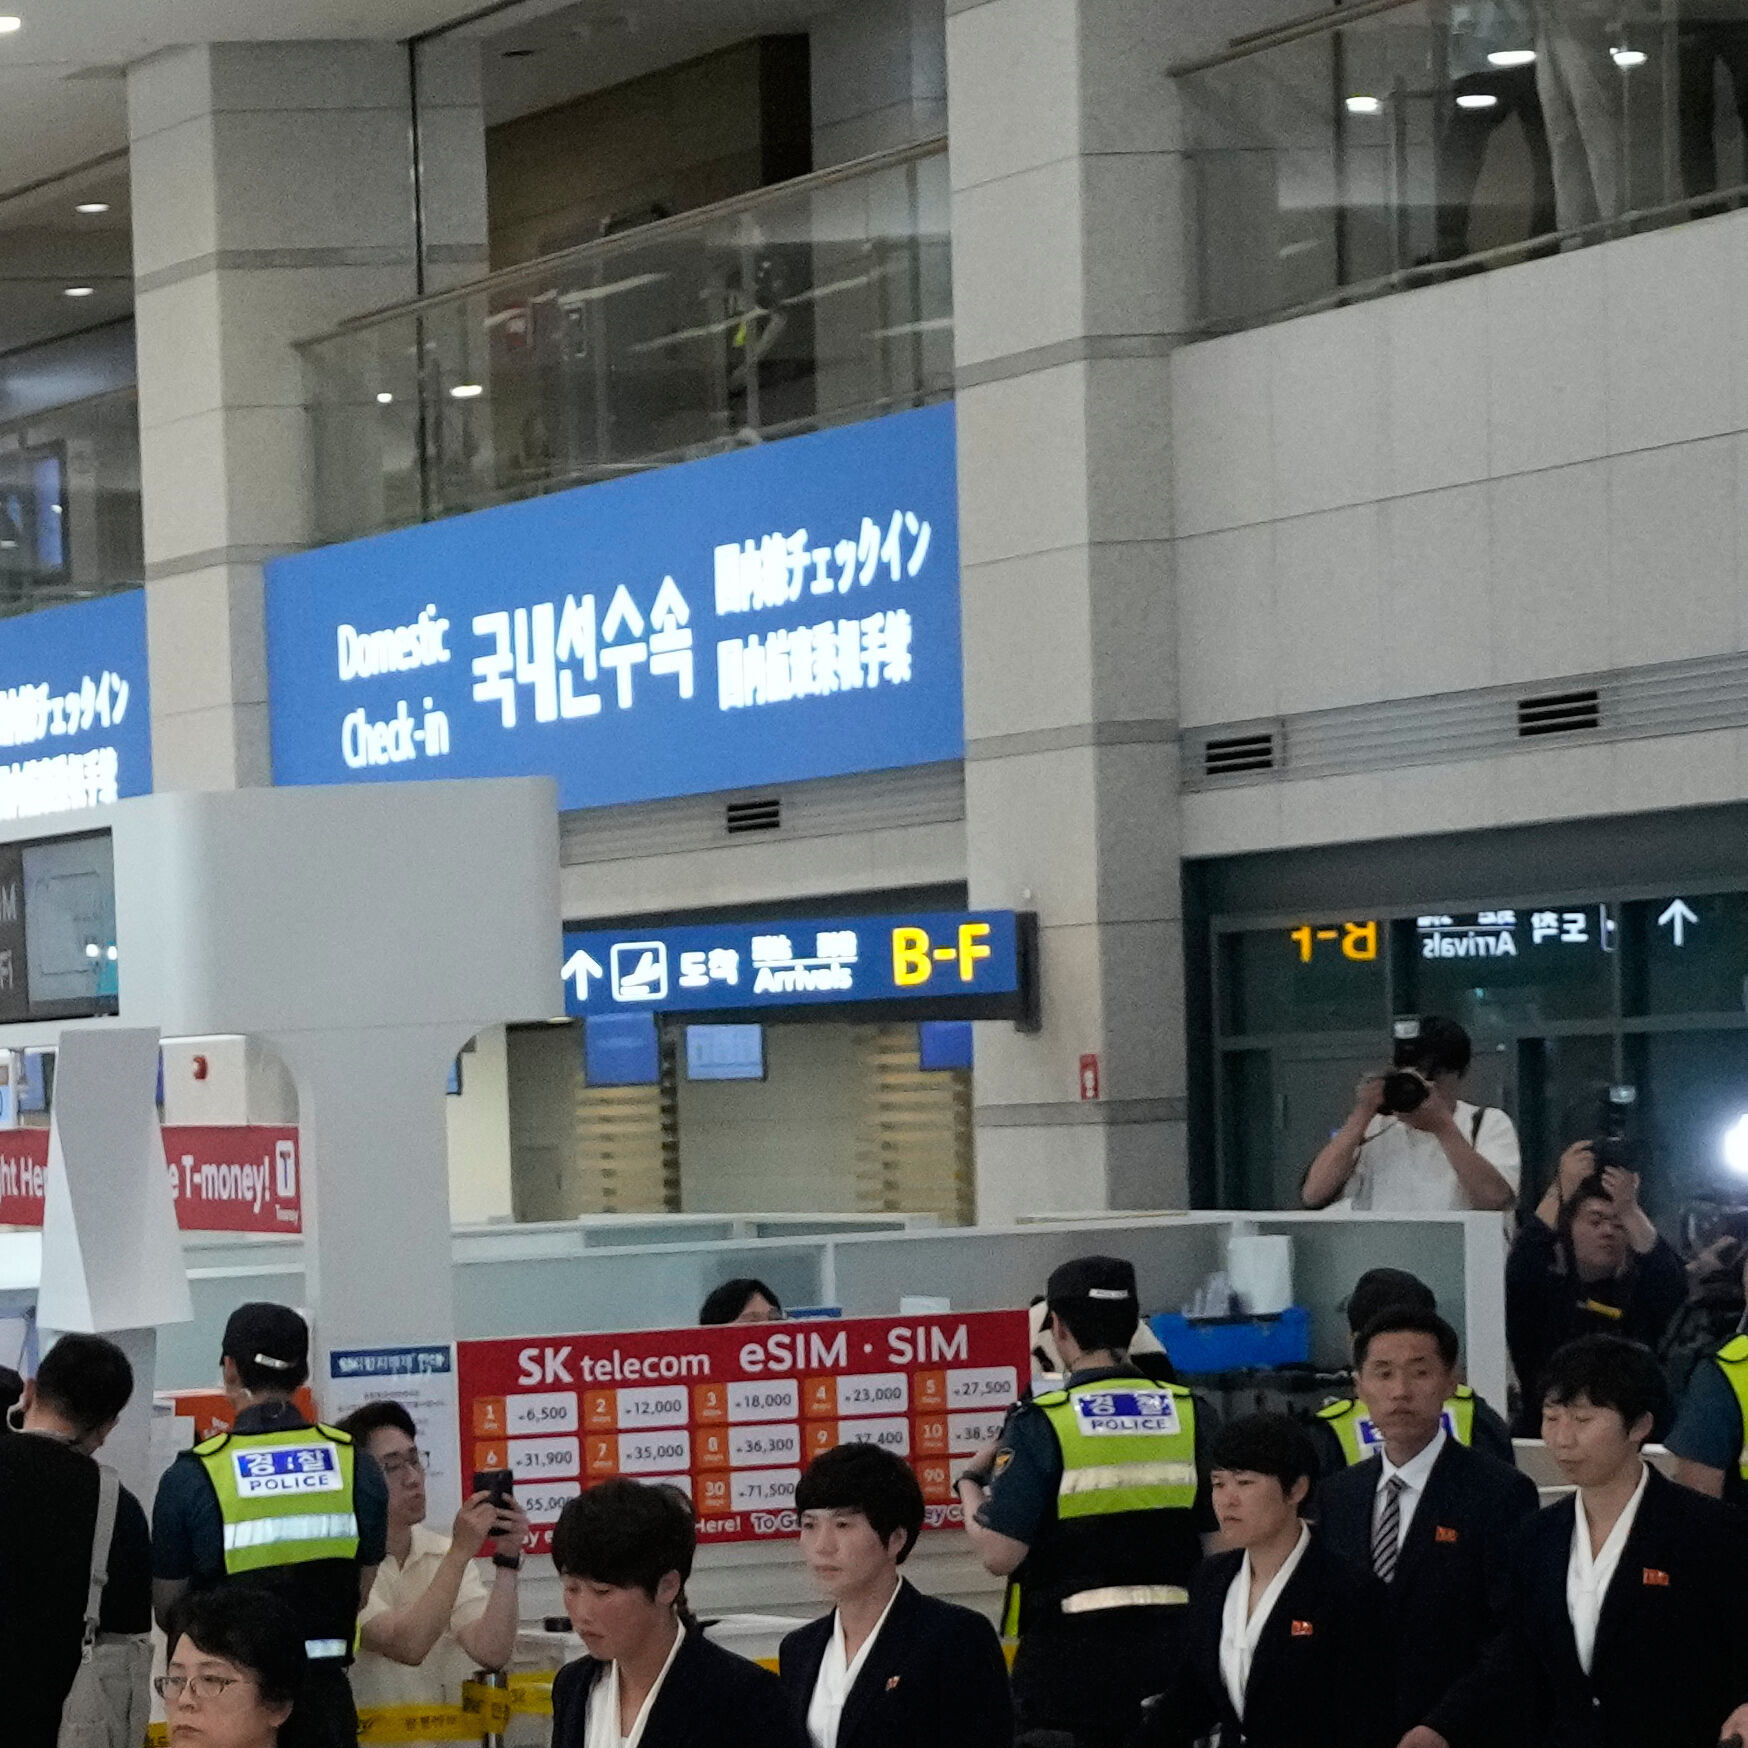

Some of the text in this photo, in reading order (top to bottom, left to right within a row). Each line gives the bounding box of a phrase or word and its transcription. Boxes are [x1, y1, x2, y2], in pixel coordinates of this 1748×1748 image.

[336, 603, 450, 682] Domestic
[471, 575, 694, 729] 국내선수속
[342, 696, 449, 769] Check-in
[892, 923, 991, 986] B-F
[679, 948, 739, 986] 도착
[754, 963, 853, 993] Arrivals
[181, 1154, 270, 1213] T-money!
[517, 1324, 968, 1386] SK telecom eSIM SIM
[706, 1391, 717, 1407] 3
[816, 1385, 827, 1400] 4
[595, 1398, 607, 1414] 2
[923, 1424, 943, 1438] 10
[1092, 1419, 1168, 1431] POLICE
[816, 1430, 828, 1444] 9
[250, 1474, 329, 1491] POLICE
[923, 1469, 944, 1482] 90
[705, 1481, 725, 1496] 30
